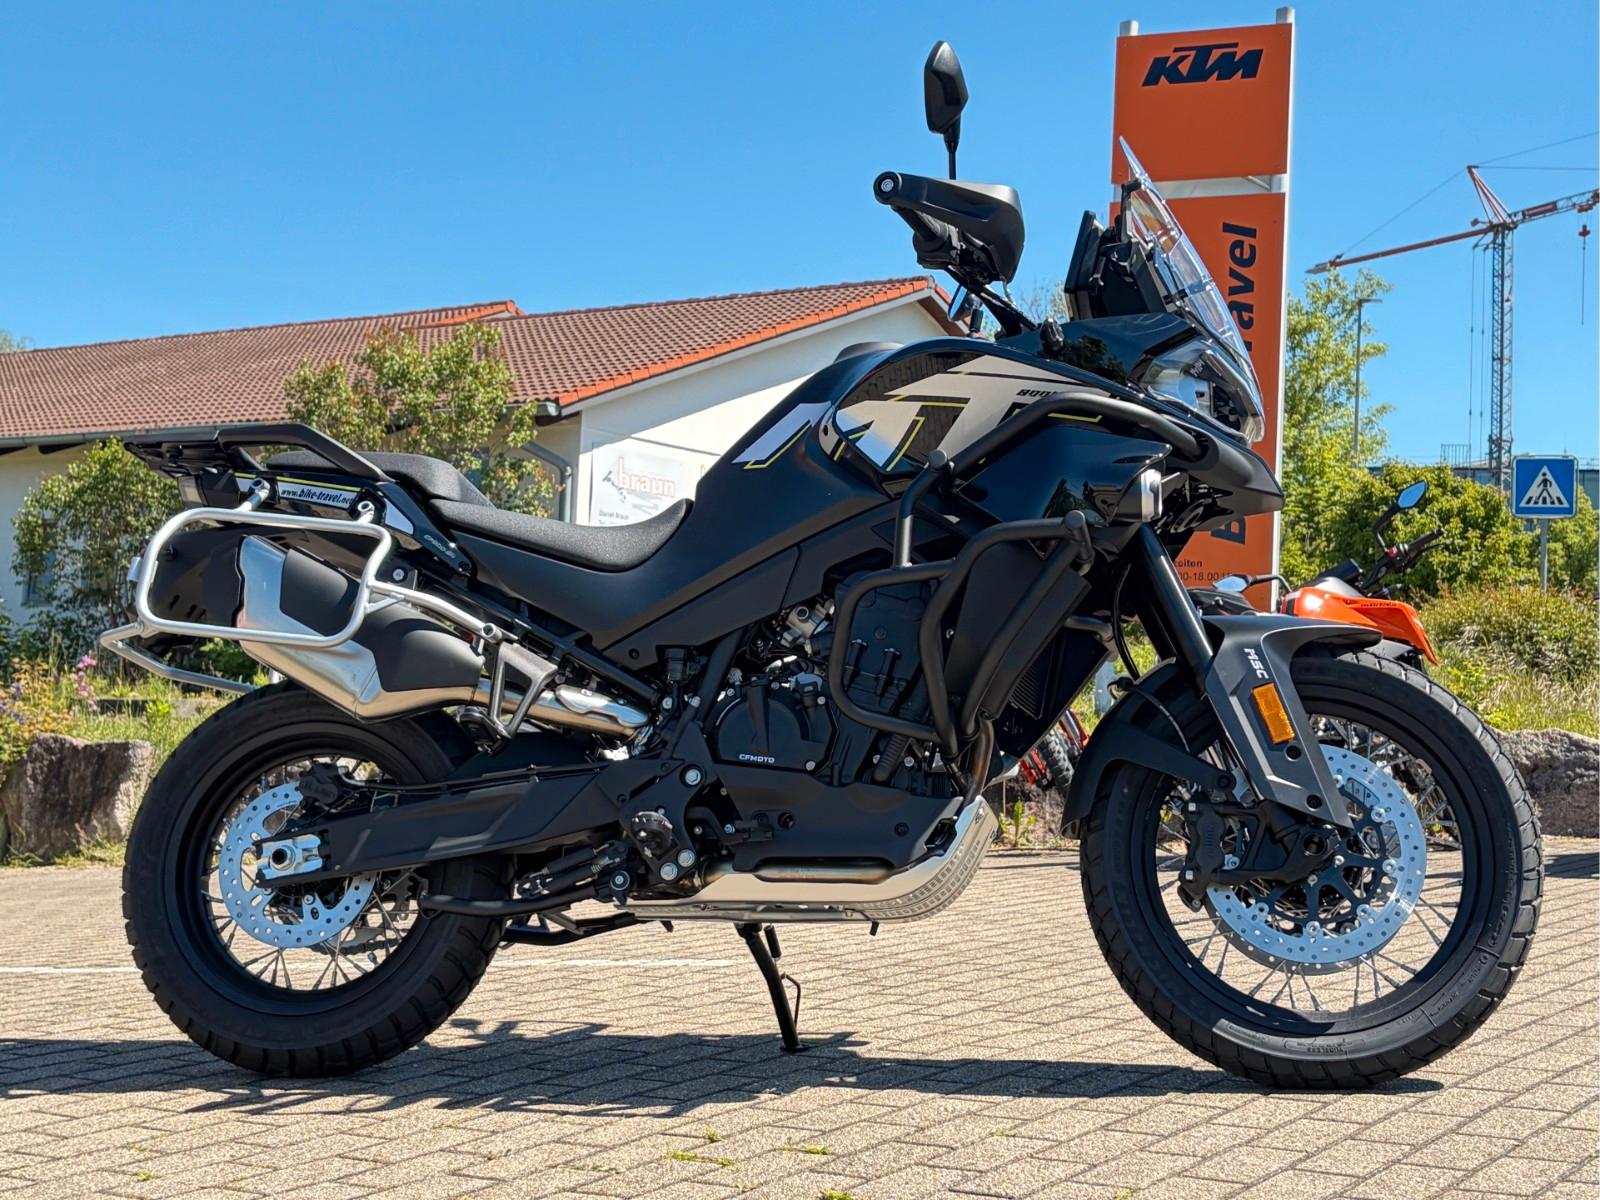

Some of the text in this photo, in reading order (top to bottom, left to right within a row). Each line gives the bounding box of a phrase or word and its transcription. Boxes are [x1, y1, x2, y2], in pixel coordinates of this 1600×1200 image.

[1142, 42, 1263, 87] KTM
[1222, 222, 1257, 352] avel
[1016, 389, 1056, 397] 800
[618, 456, 676, 497] braun
[1243, 648, 1269, 679] MSC
[739, 753, 775, 764] CFMOTO
